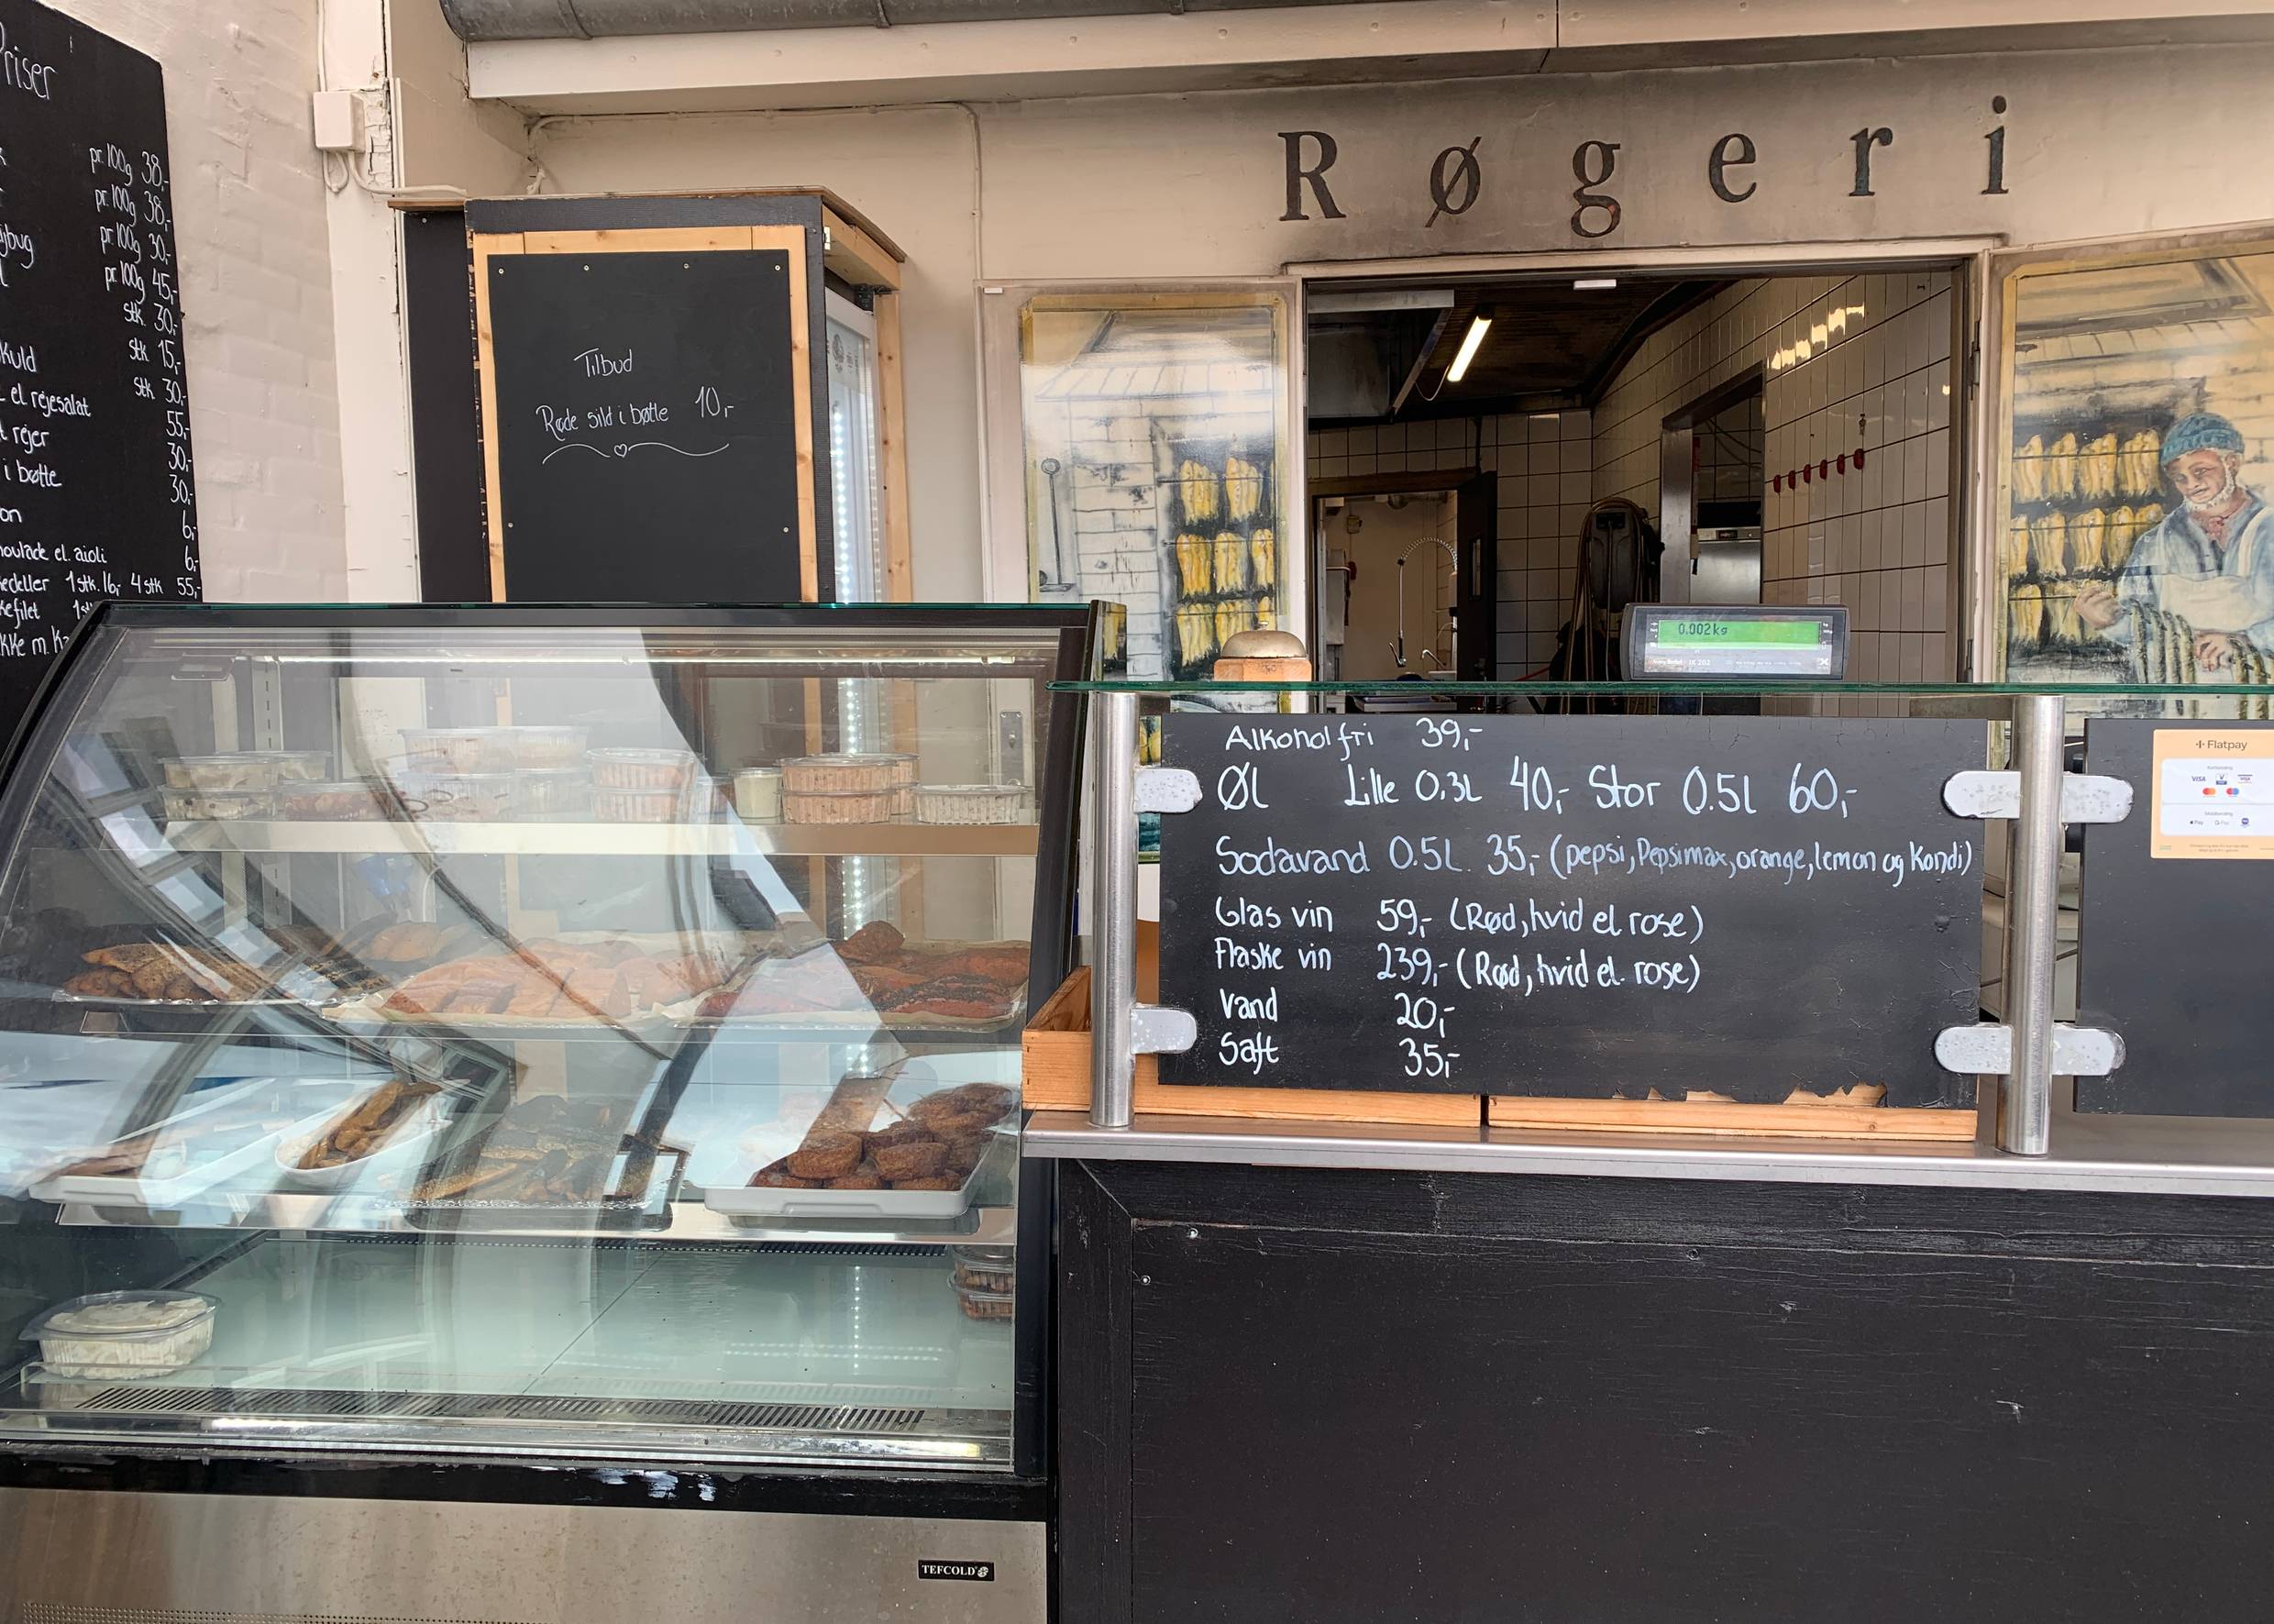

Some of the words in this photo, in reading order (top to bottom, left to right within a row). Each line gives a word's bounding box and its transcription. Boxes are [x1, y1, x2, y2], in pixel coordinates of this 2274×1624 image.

[107, 143, 133, 186] 100g
[141, 151, 169, 192] 38,-
[1277, 95, 2010, 238] Røgeri
[111, 183, 137, 227] 100g
[143, 191, 171, 232] 38,-
[116, 222, 141, 263] 100g
[149, 233, 171, 265] 30,-
[120, 260, 146, 304] 100g
[152, 268, 178, 305] 45,-
[153, 303, 178, 336] 30,-
[0, 341, 37, 372] kuld
[161, 378, 187, 406] 30,-
[158, 339, 182, 375] 15,-
[574, 348, 633, 378] Tilbud
[166, 410, 190, 440] 55,-
[535, 404, 579, 441] Røde
[587, 405, 613, 429] sild
[618, 404, 627, 425] i
[630, 401, 669, 426] bøtte
[694, 385, 734, 418] 10,-
[167, 442, 192, 472] 30,-
[3, 458, 11, 481] i
[170, 474, 193, 505] 30,-
[182, 509, 196, 541] 6,-
[73, 545, 106, 564] aioli
[184, 545, 199, 572] 6,-
[176, 577, 201, 600] 55,-
[1416, 717, 1484, 751] 39,-
[2207, 739, 2248, 752] Flatpay
[1343, 763, 1400, 806] Lille
[1509, 755, 1571, 815] 40,-
[1588, 763, 1661, 810] Stor
[1789, 762, 1859, 819] 60,-
[1215, 834, 1372, 877] Sodavand
[1485, 834, 1541, 877] 35,-
[1882, 853, 1904, 888] og
[1214, 895, 1283, 928] Glas
[1290, 899, 1333, 933] vin
[1375, 898, 1433, 939] 59,-
[1628, 904, 1705, 945] rose)
[1214, 936, 1285, 970] Flaske
[1297, 942, 1332, 971] vin
[1376, 942, 1449, 988] 239,-
[1633, 953, 1701, 994] rose)
[1394, 991, 1456, 1039] 20,-
[1218, 1031, 1280, 1076] Saft
[1398, 1036, 1461, 1078] 35,-
[921, 1563, 977, 1576] TEFCOLD
